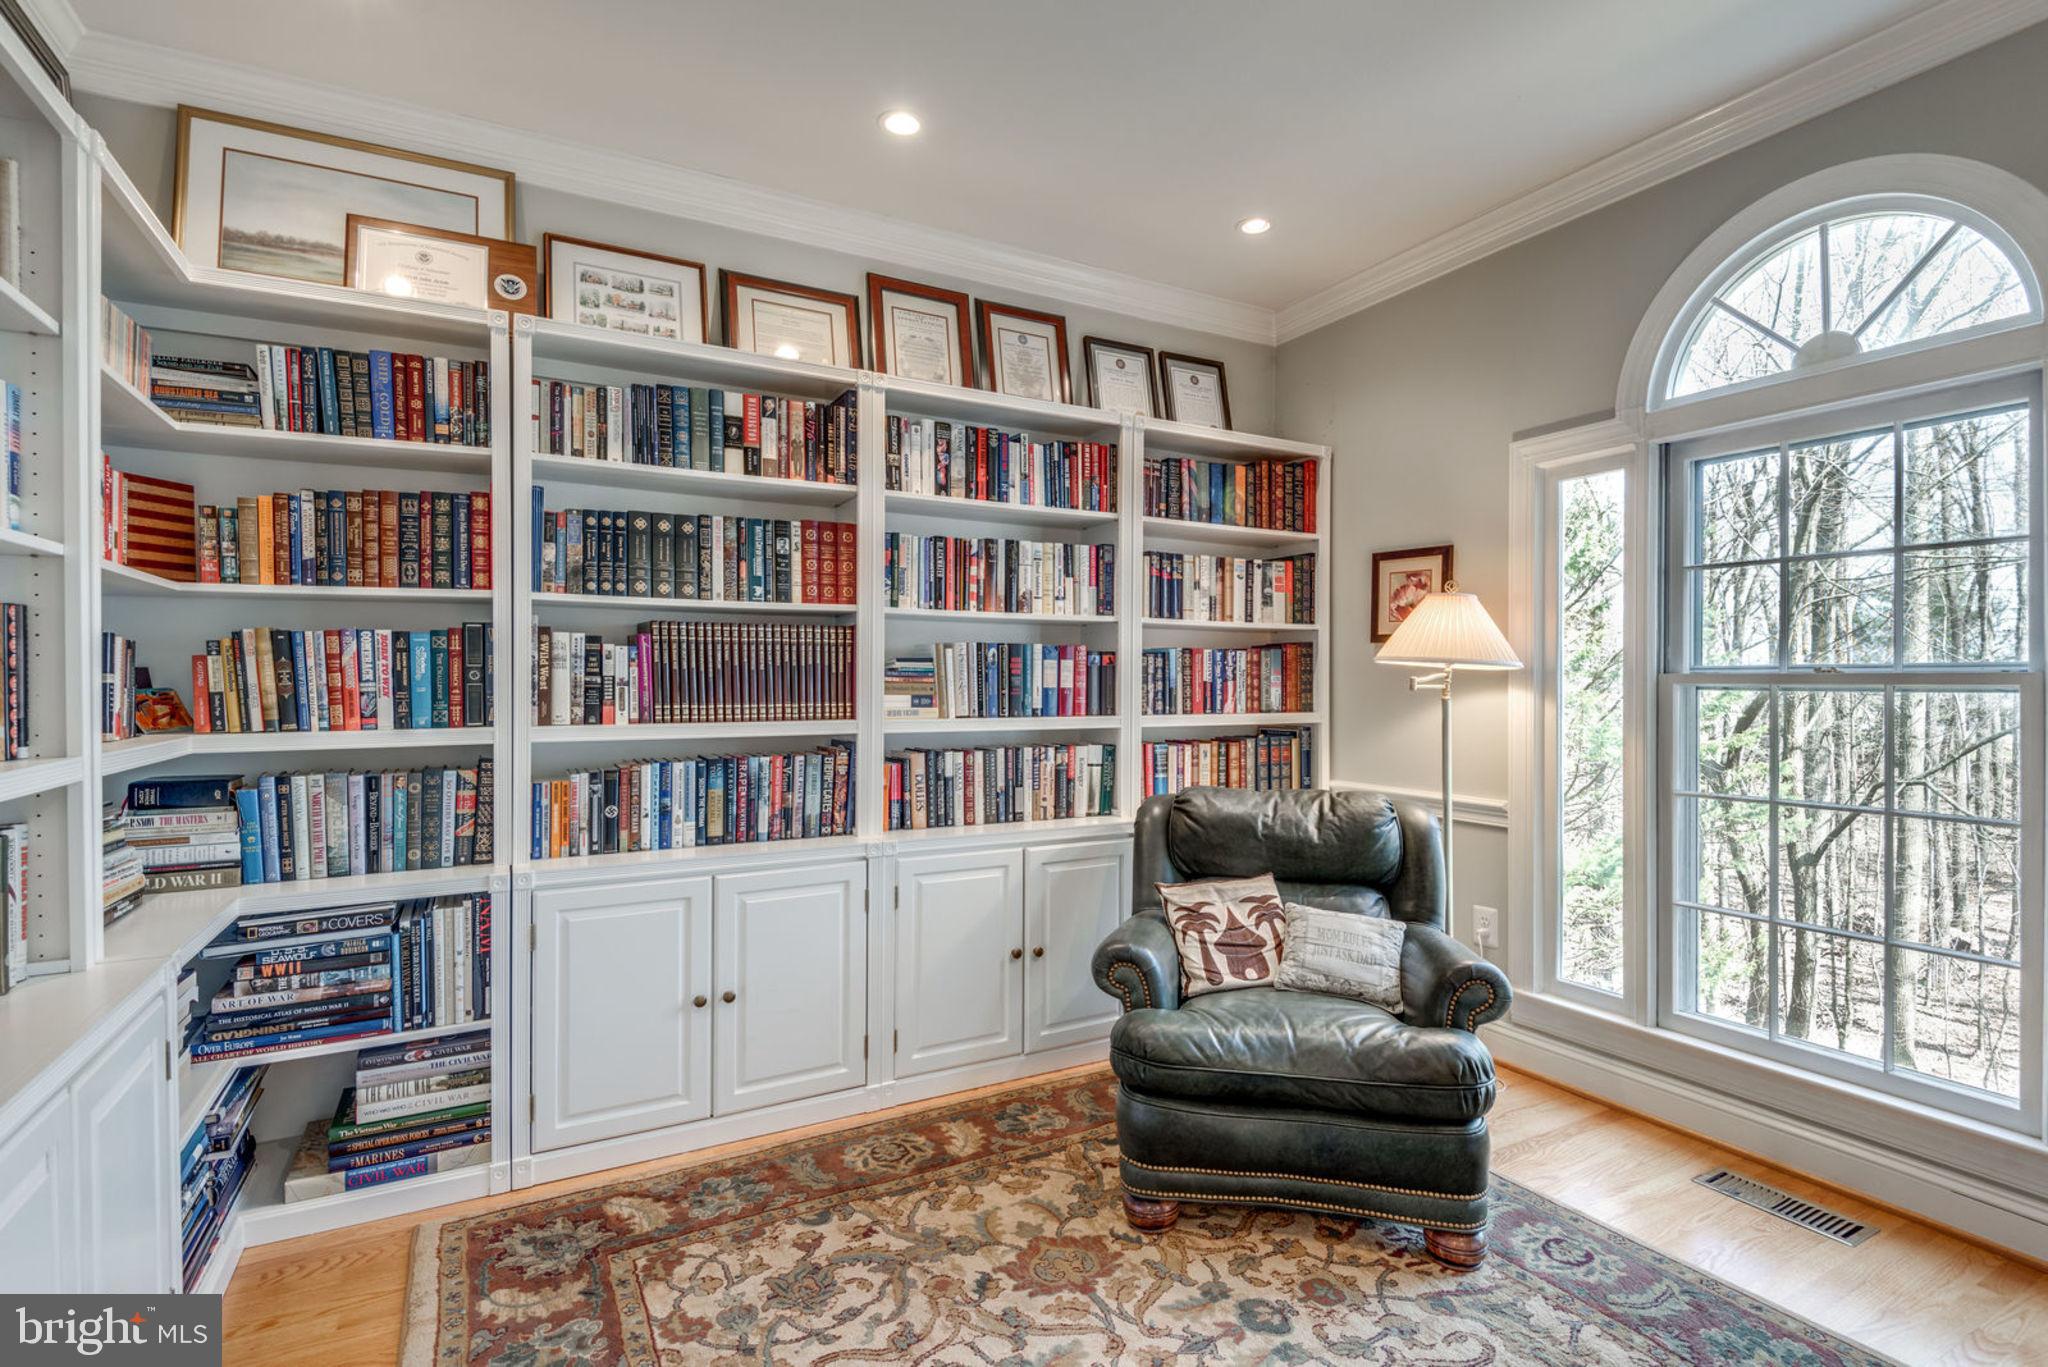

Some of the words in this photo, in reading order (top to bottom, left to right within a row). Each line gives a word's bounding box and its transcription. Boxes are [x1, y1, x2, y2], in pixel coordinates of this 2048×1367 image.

[379, 354, 388, 383] SHIP
[380, 392, 390, 426] GOLD
[746, 397, 758, 442] WASHINGTON
[805, 420, 816, 441] 1776
[936, 541, 944, 578] BLACKWATER
[361, 631, 373, 682] COMEBACK
[381, 634, 389, 661] BORN
[539, 641, 548, 666] Wild
[381, 663, 389, 677] TO
[539, 666, 549, 690] West
[382, 677, 390, 699] WIN
[436, 665, 444, 700] CHALLENGE
[738, 765, 747, 794] RAPE
[823, 757, 833, 783] ENEMY
[1077, 757, 1085, 789] Kissinger
[822, 789, 832, 813] GATES
[915, 773, 925, 812] DULLES
[311, 791, 323, 818] NORTH
[312, 819, 322, 829] TO
[630, 804, 639, 834] EICHMANN
[312, 830, 323, 845] THE
[313, 846, 324, 865] POLE
[171, 874, 206, 887] WAR
[328, 913, 384, 930] COVERS
[479, 898, 493, 955] NAM
[261, 950, 319, 965] SEAWOLF
[1336, 948, 1356, 963] ASK
[1357, 951, 1378, 966] DAD
[221, 999, 244, 1010] ART
[248, 997, 264, 1005] OF
[267, 993, 295, 1004] WAR
[233, 1013, 272, 1023] HISTORICAL
[274, 1010, 292, 1018] ATLAS
[304, 1005, 327, 1013] WORLD
[211, 1023, 296, 1042] LENINGRAD
[210, 1050, 241, 1060] CHART
[243, 1049, 255, 1057] OF
[256, 1044, 285, 1054] WORLD
[288, 1039, 324, 1051] HISTORY
[433, 1048, 452, 1056] CIVIL
[453, 1045, 472, 1053] WAR
[429, 1060, 446, 1070] THE
[448, 1056, 471, 1066] CIVIL
[365, 1085, 381, 1103] THE
[386, 1081, 411, 1101] CIVIL
[415, 1094, 444, 1108] CIVIL
[447, 1091, 470, 1102] WAR
[339, 1129, 354, 1139] The
[355, 1124, 382, 1135] Vietnam
[382, 1121, 397, 1131] War
[355, 1149, 406, 1167] MARINES
[348, 1171, 390, 1188] CIVIL
[394, 1162, 427, 1178] WAR
